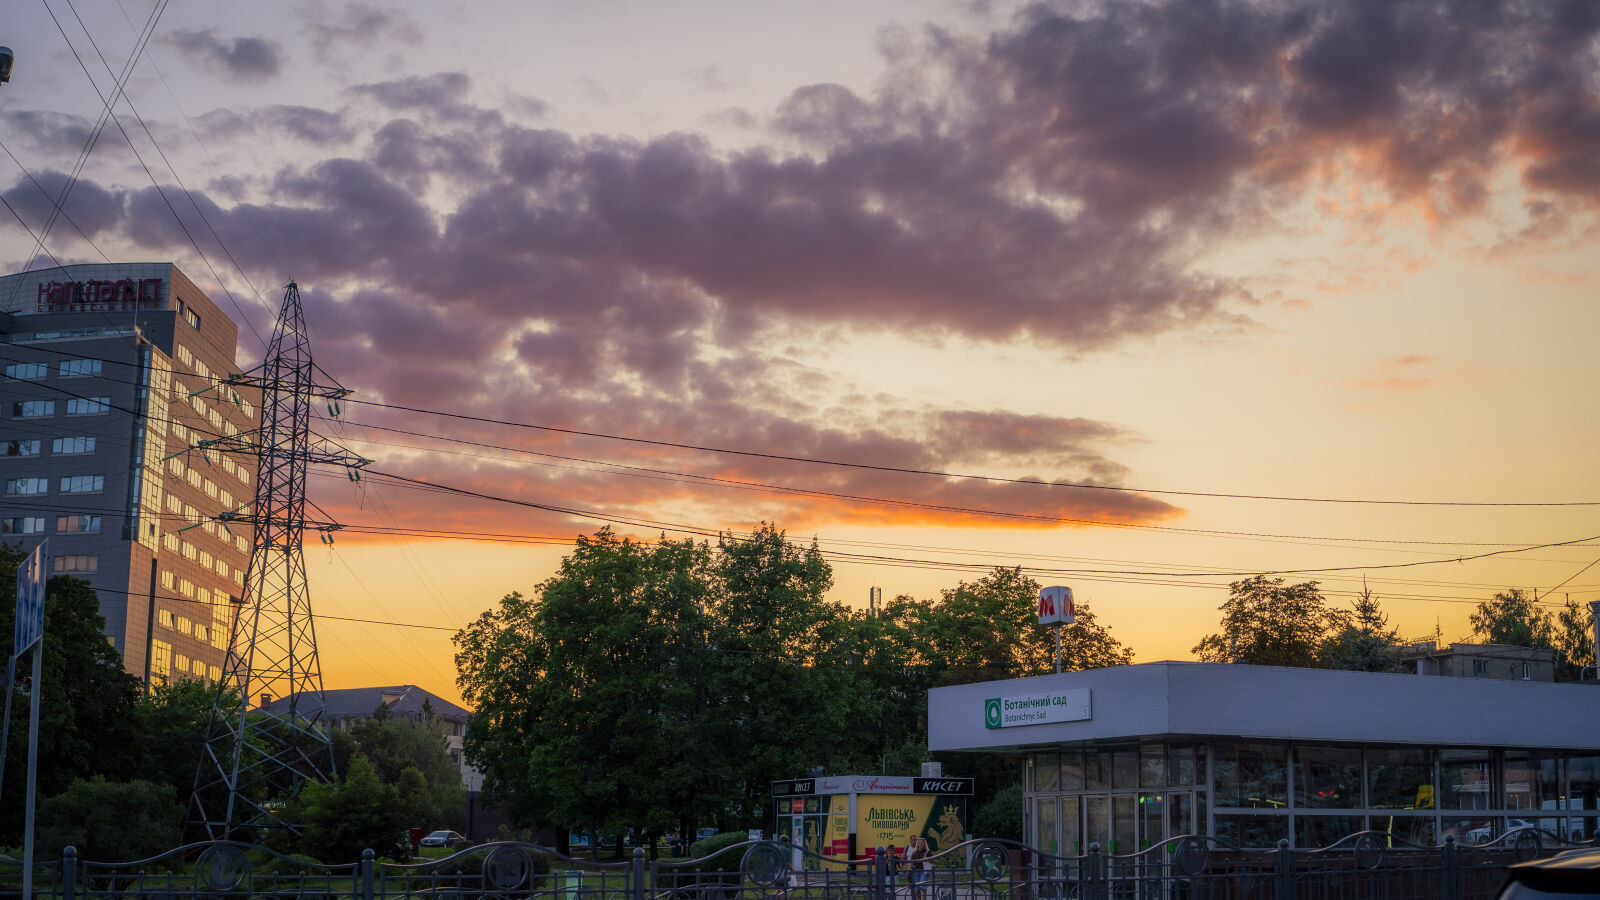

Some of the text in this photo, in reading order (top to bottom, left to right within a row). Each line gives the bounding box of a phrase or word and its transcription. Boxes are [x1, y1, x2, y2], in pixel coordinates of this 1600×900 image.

[1004, 695, 1067, 710] Ботанічний сад
[1036, 710, 1046, 719] Sad
[921, 780, 965, 792] КИСЕТ
[872, 820, 910, 830] ПИВОВАРНЯ
[880, 832, 894, 840] 1715
